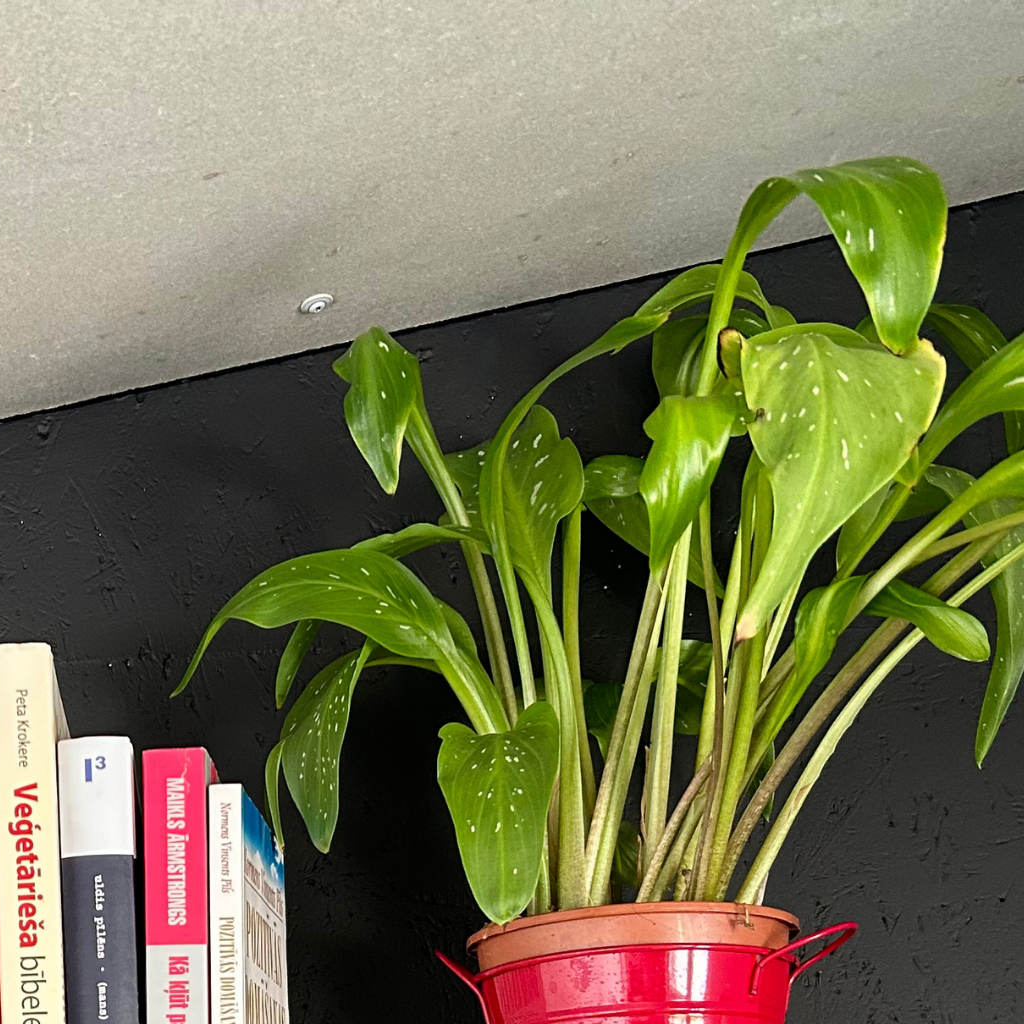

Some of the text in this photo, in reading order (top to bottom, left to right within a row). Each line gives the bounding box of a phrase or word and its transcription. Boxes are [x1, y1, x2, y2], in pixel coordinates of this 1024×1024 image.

[16, 688, 30, 768] Peta Krokere
[8, 782, 45, 948] Veģetārieša
[166, 777, 189, 926] MAIKLS ĀRMSTRONGS
[221, 841, 232, 876] Vinsents
[94, 874, 105, 911] uldis
[94, 916, 106, 959] pīlēns
[219, 916, 238, 973] POZITĪVĀS
[168, 956, 189, 975] Kā
[97, 982, 109, 1020] (mans)
[163, 980, 189, 1009] kļūt
